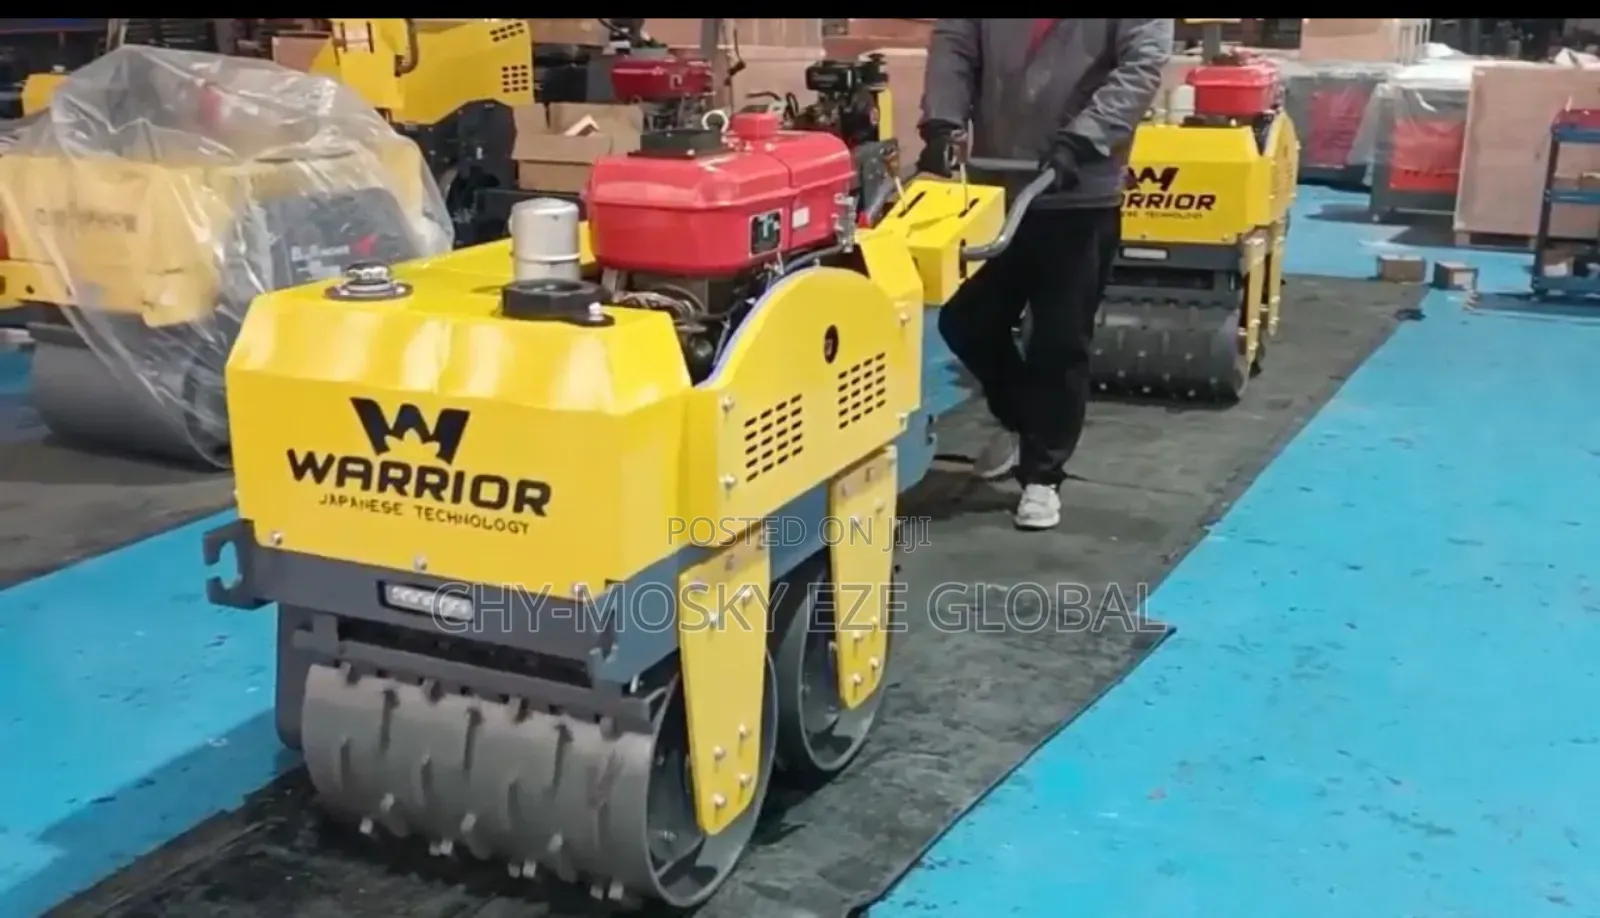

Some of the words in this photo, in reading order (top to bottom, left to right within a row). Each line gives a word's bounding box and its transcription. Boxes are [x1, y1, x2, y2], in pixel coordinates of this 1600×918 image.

[286, 448, 552, 517] WARRIOR
[318, 493, 404, 516] JAPANESE
[413, 504, 531, 535] TECHNOLOGY
